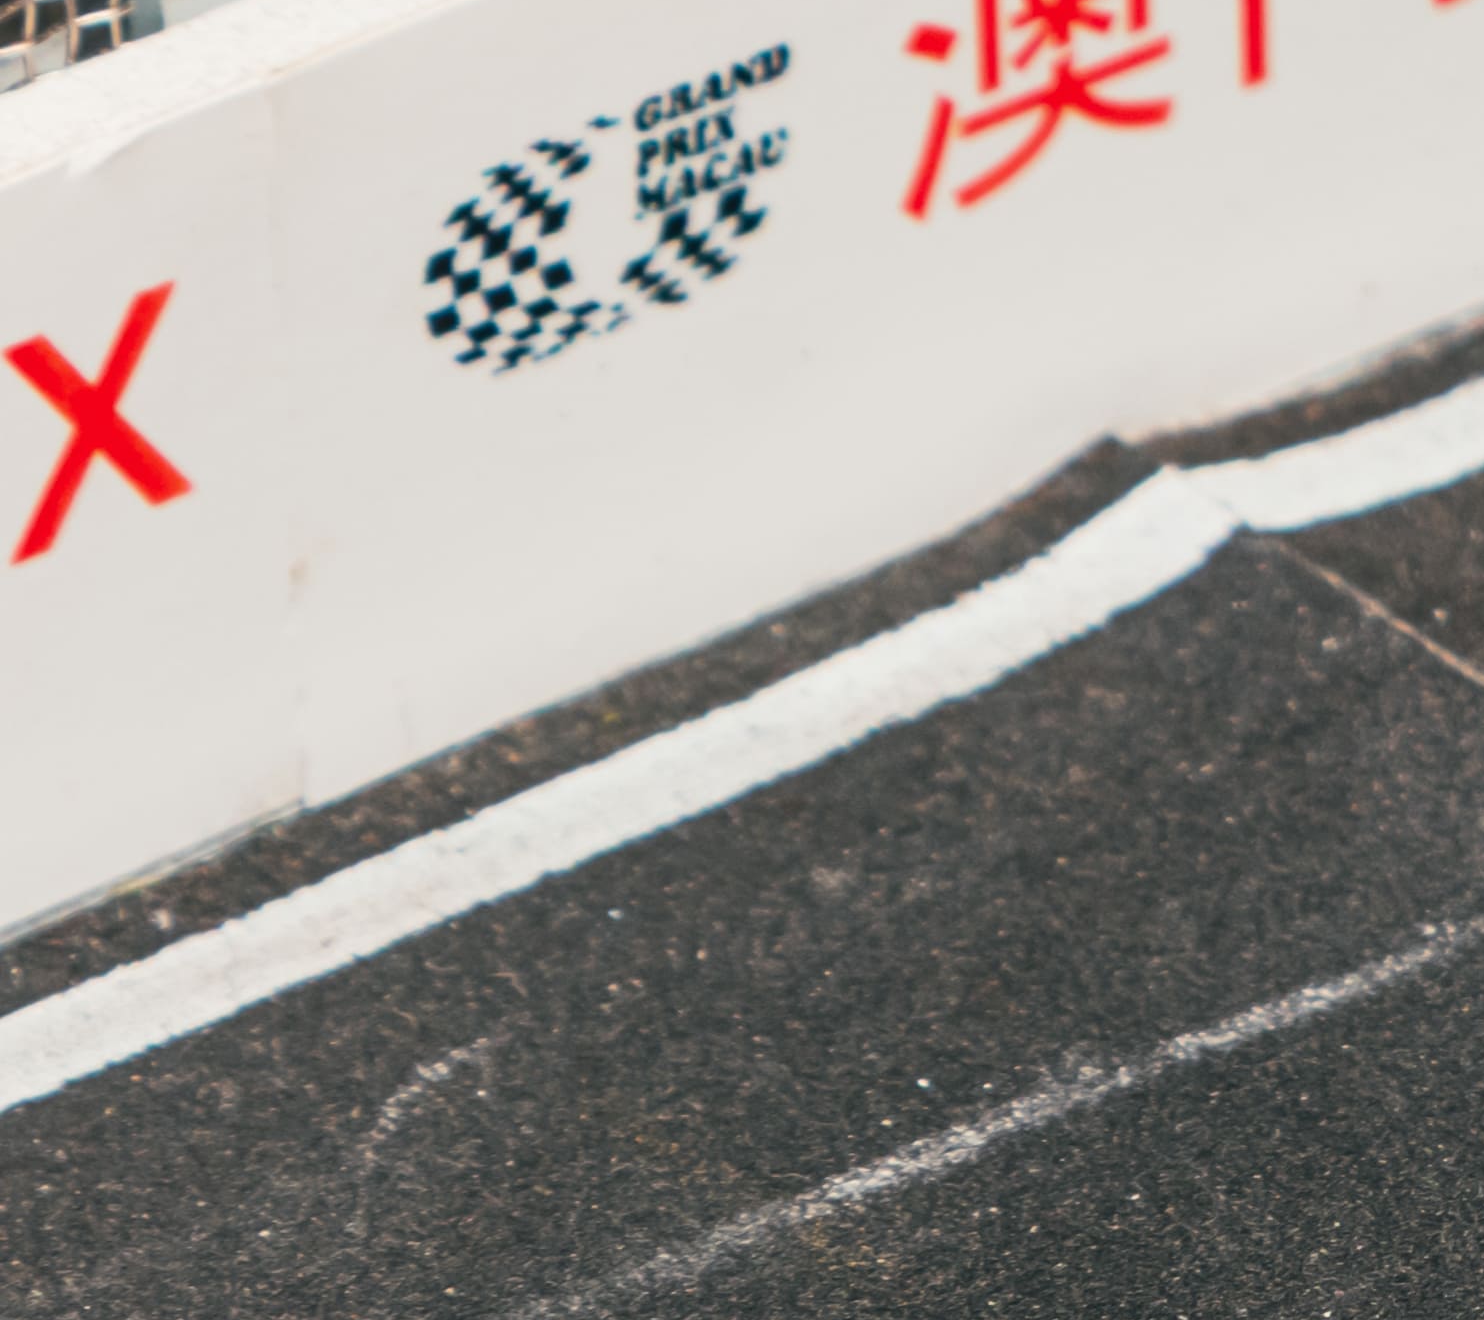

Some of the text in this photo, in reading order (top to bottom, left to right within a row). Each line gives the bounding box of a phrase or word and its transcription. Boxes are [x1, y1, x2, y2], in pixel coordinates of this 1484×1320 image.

[634, 43, 790, 131] GRAND
[634, 128, 789, 215] MACAU
[637, 106, 735, 177] PRIX
[3, 279, 193, 565] X
